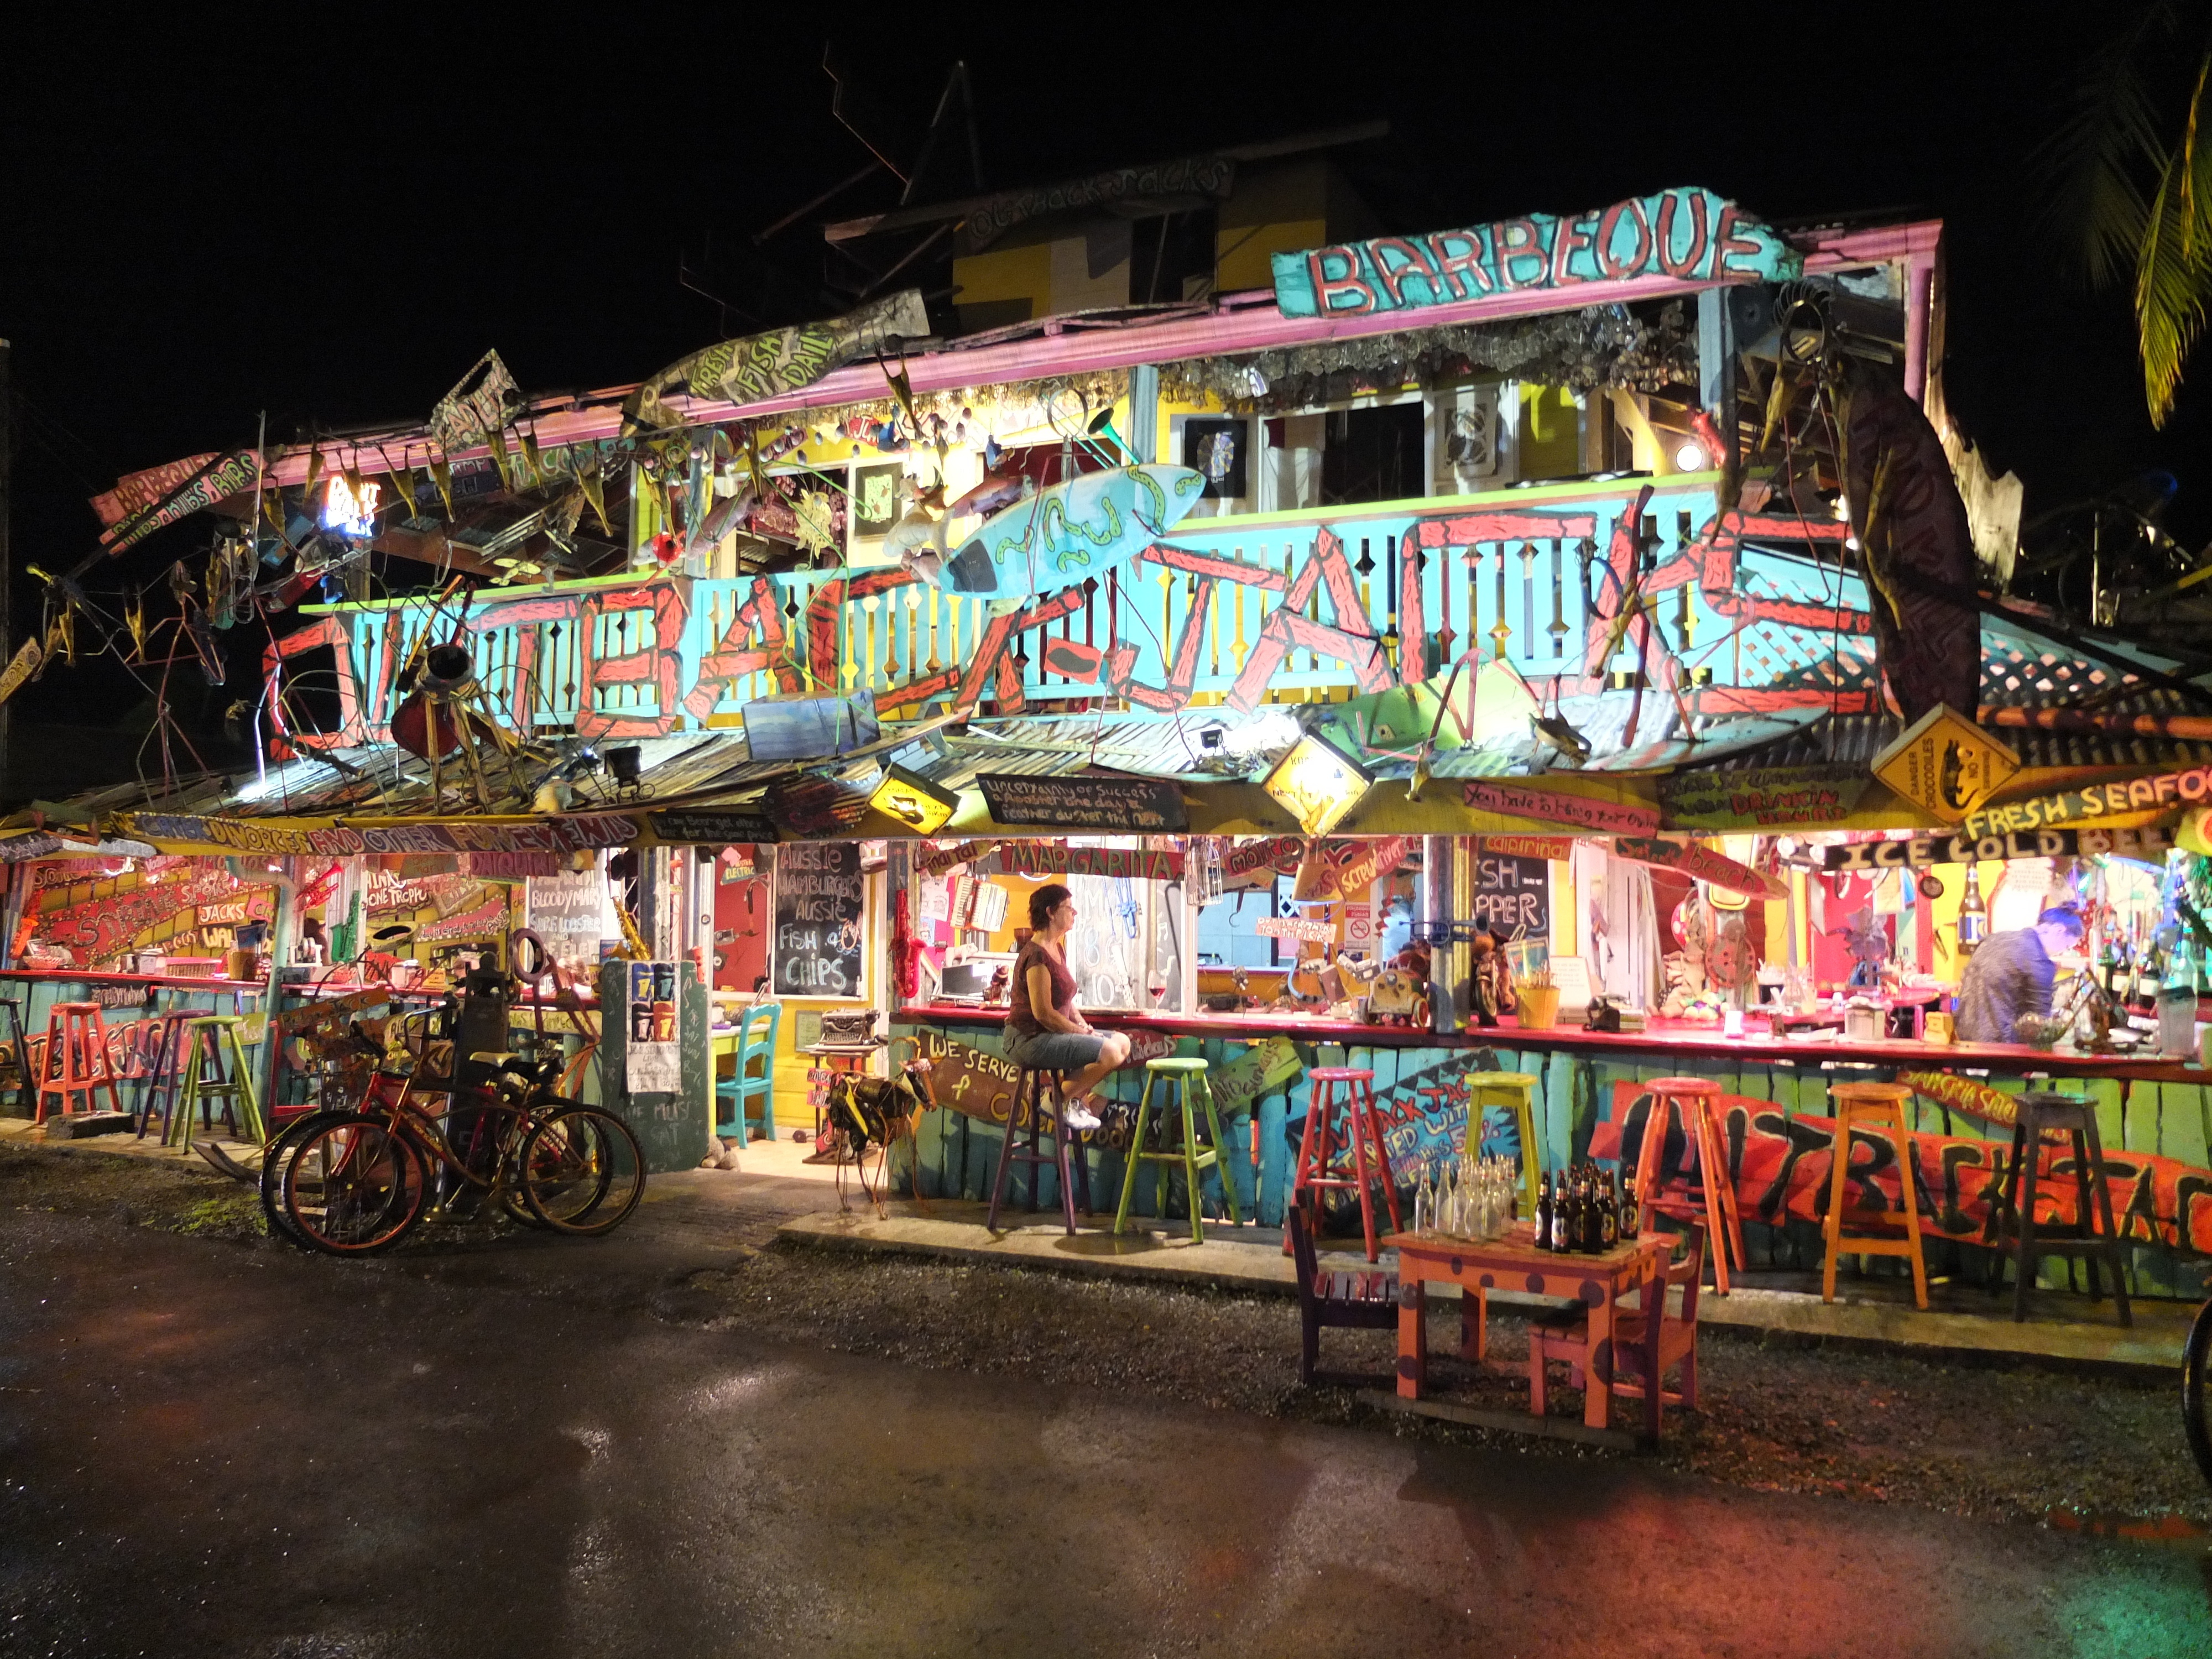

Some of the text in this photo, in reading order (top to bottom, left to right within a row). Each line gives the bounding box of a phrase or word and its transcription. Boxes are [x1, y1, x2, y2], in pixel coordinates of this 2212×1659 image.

[1306, 192, 1764, 317] BARBEQUE
[1908, 751, 1919, 795] DANGER
[1921, 738, 1936, 808] CROCODILES
[1968, 762, 1978, 779] NO
[307, 828, 364, 855] AND
[364, 825, 455, 853] OTHER
[1965, 800, 2068, 841] FRESH
[1010, 842, 1176, 881] MARGARITA
[1689, 843, 1756, 891] beach
[1840, 837, 1936, 870] ICE
[1949, 831, 2065, 863] COLD
[726, 866, 755, 880] ELECTRIC
[199, 903, 246, 924] JACKS
[531, 886, 603, 914] BLOODY MARY
[929, 1033, 1021, 1083] WE SERVE
